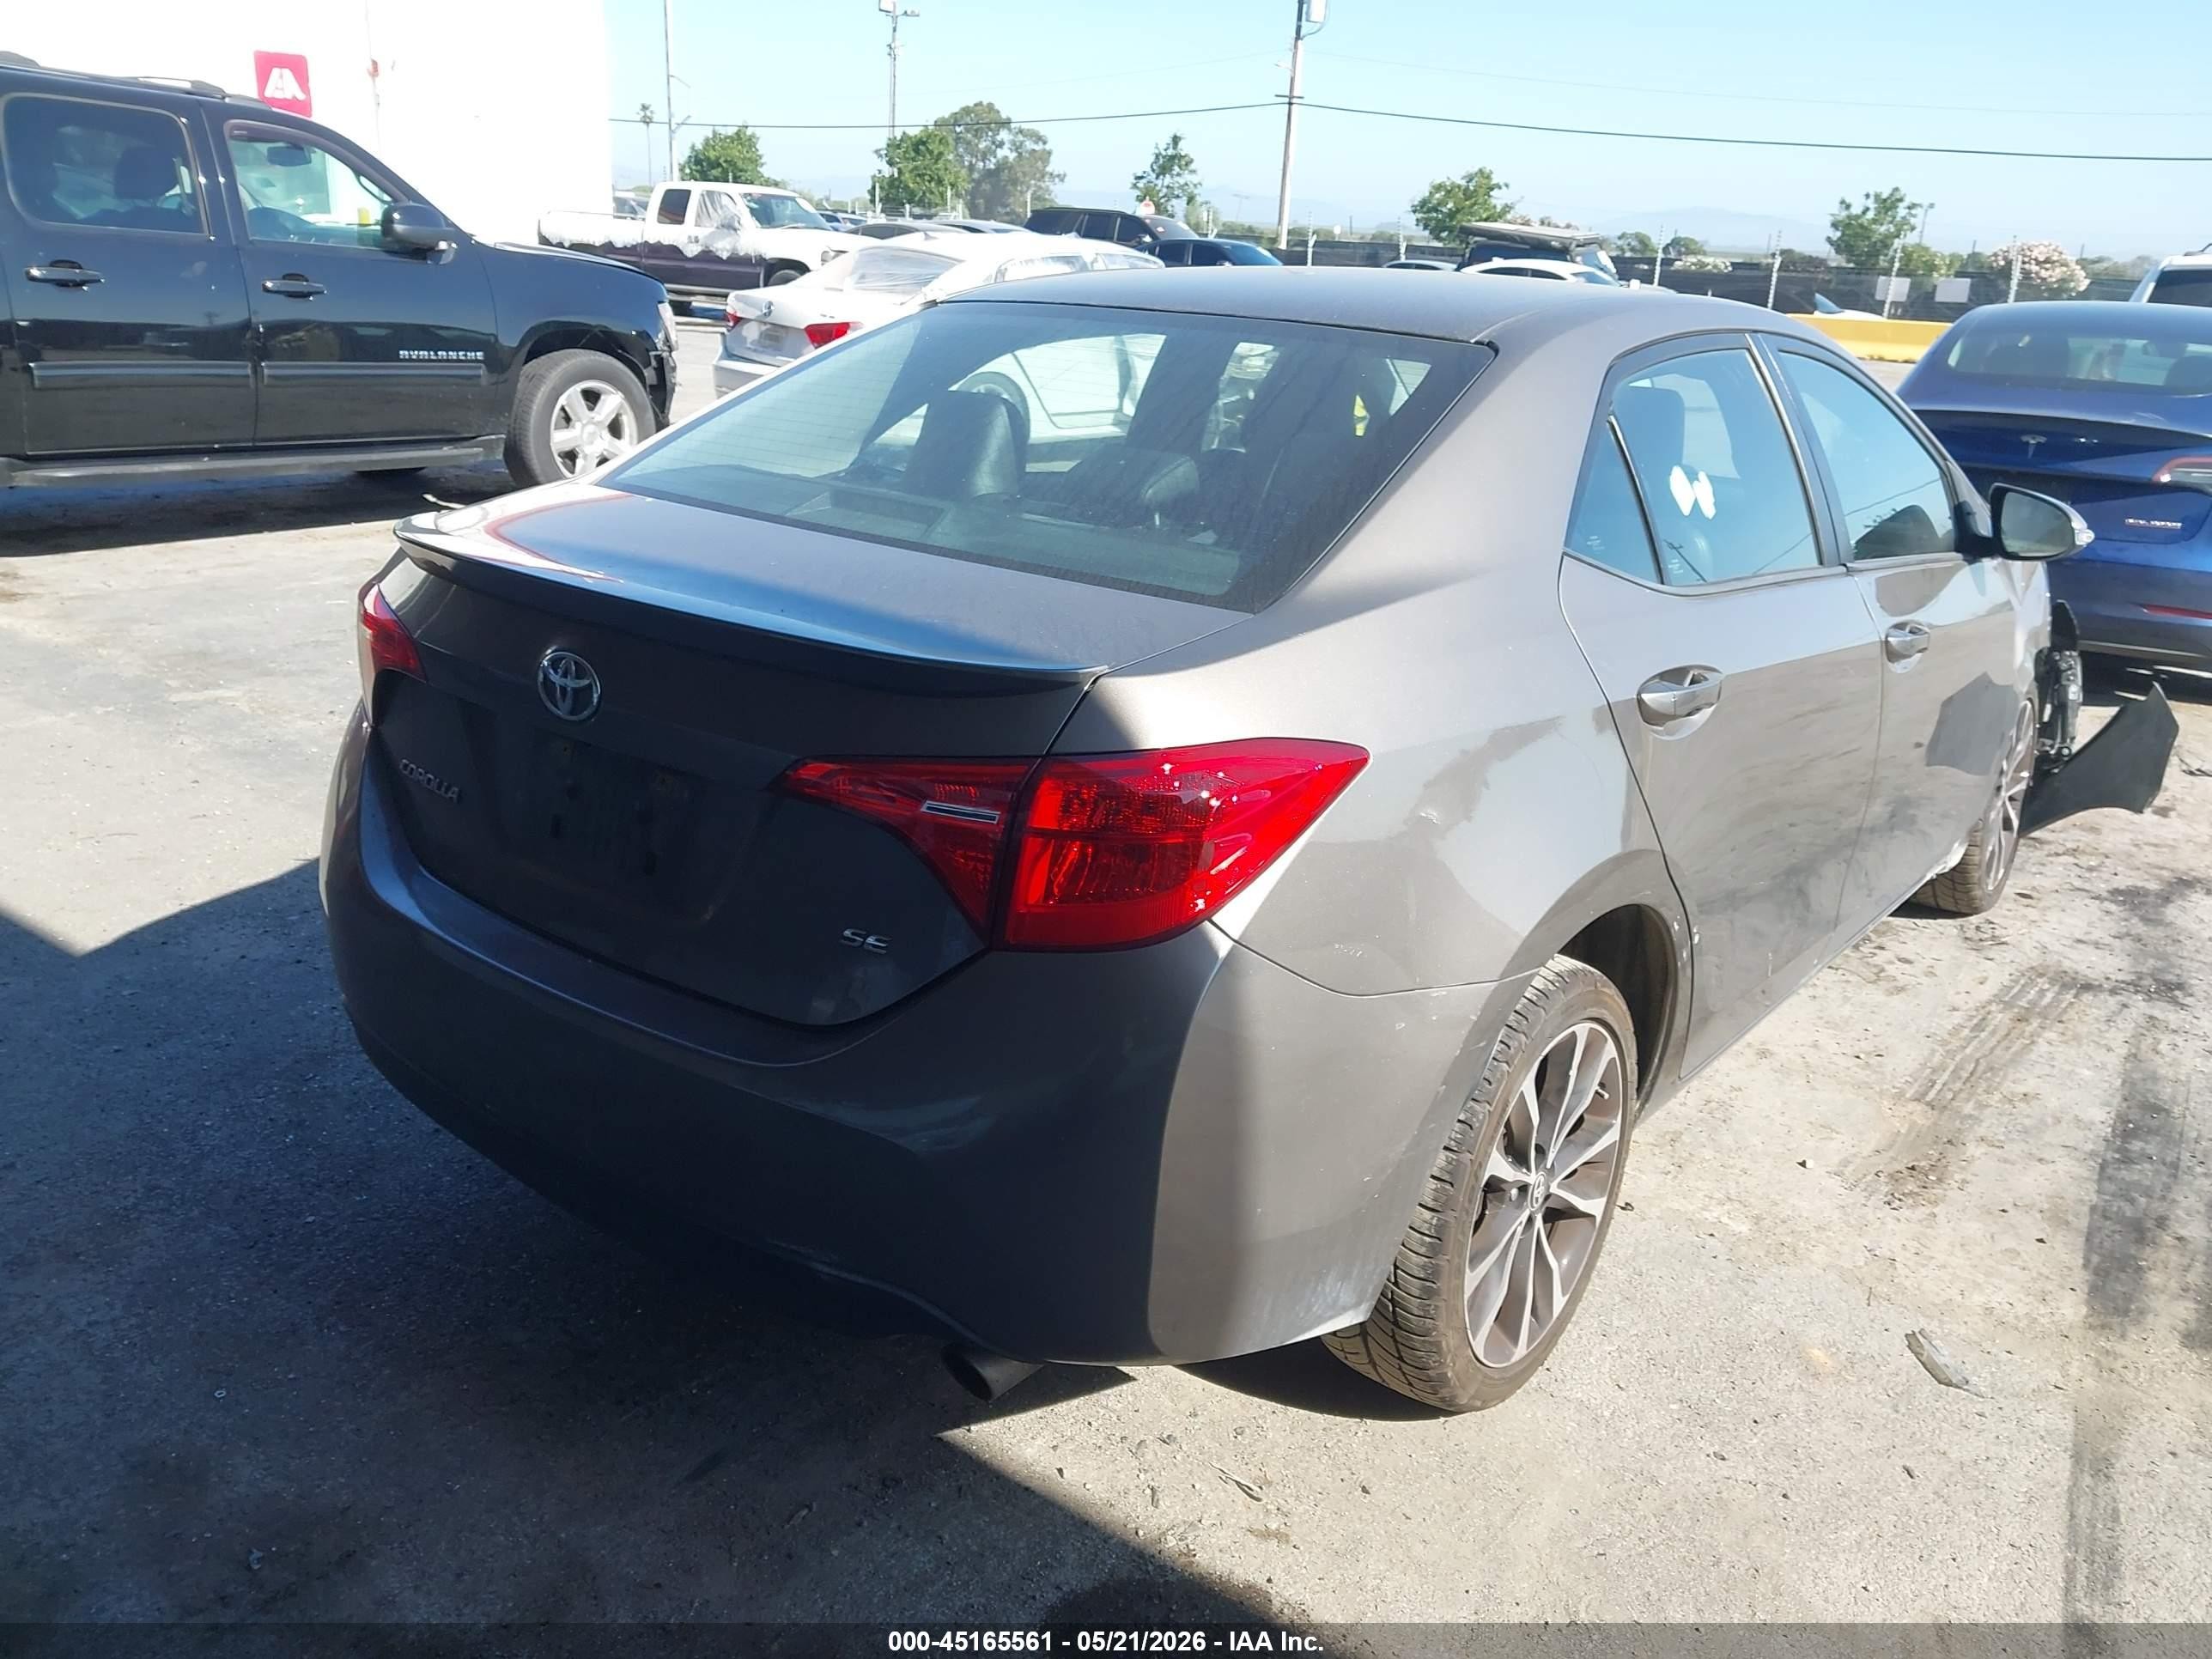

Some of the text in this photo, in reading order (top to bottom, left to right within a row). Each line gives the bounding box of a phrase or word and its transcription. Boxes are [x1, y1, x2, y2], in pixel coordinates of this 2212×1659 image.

[398, 349, 484, 360] AVALANCHE
[399, 759, 459, 803] COROLLA
[841, 928, 891, 954] SE
